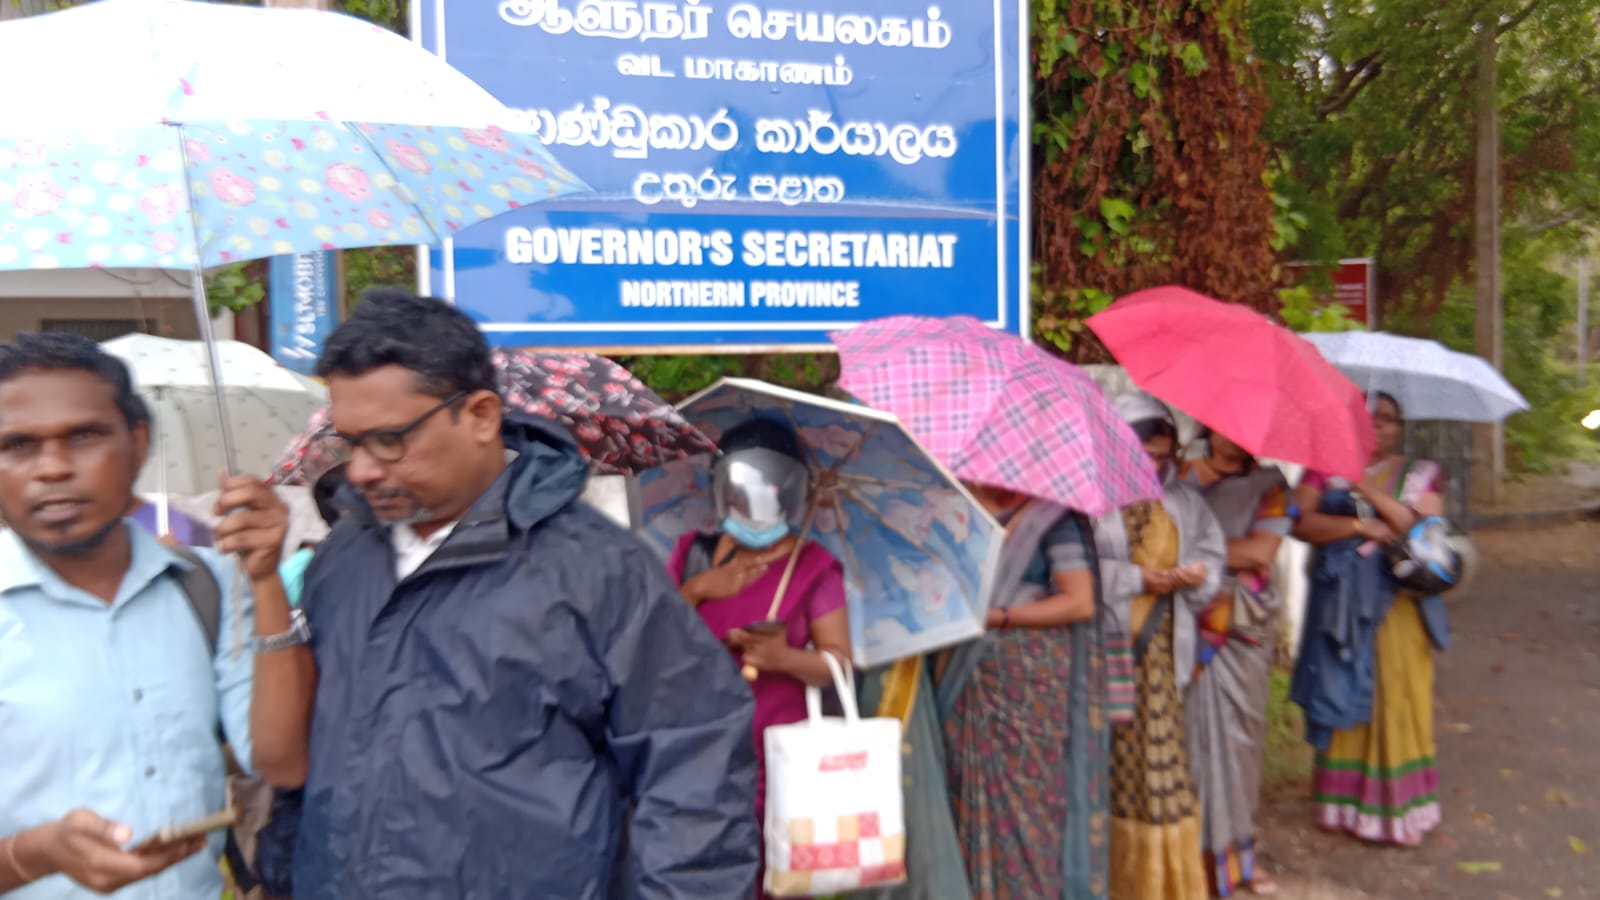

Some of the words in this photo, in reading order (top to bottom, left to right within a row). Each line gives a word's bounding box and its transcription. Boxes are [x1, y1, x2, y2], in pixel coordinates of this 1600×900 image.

[499, 0, 712, 42] ஆளுநர்
[727, 4, 951, 48] செயலகம்
[617, 54, 675, 77] வட
[684, 54, 853, 85] மாகாணம்
[755, 109, 957, 165] කාර්යාලය
[633, 168, 737, 208] උතුරු
[750, 176, 844, 206] පළාත
[506, 227, 734, 266] GOVERNOR'S
[742, 230, 957, 267] SECRETARIAT
[621, 280, 745, 307] NORTHERN
[751, 281, 860, 307] PROVINCE
